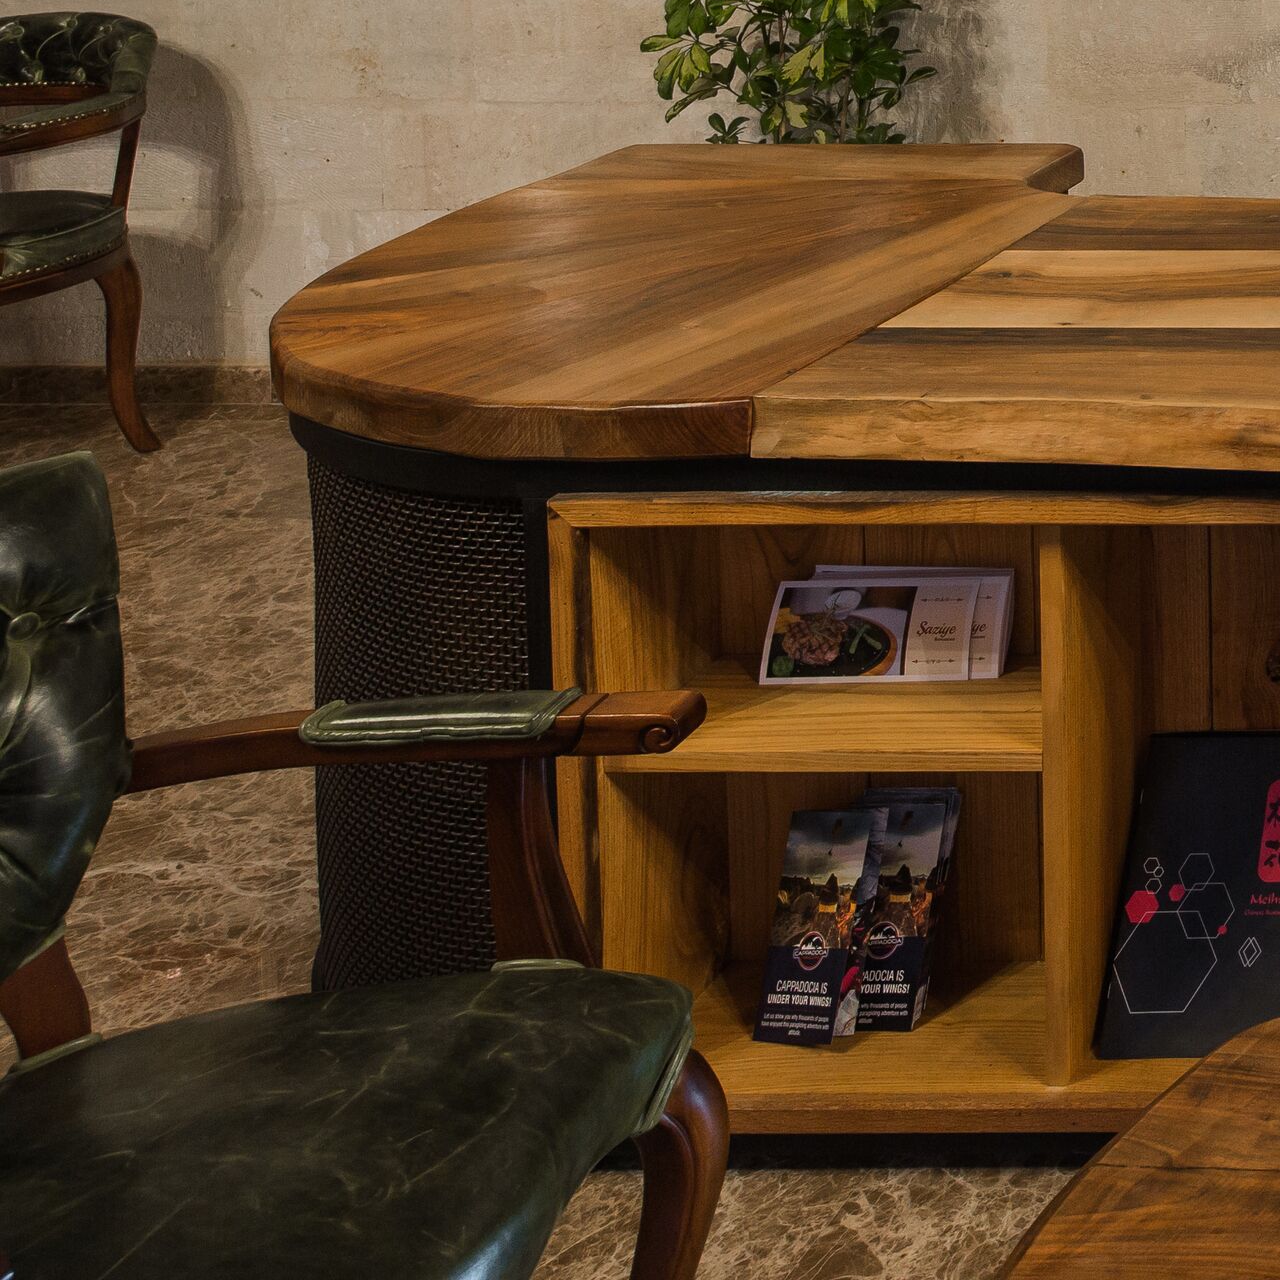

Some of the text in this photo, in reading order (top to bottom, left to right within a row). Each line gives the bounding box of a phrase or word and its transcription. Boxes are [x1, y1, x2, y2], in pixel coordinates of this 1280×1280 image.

[862, 970, 904, 981] ADOCIA IS
[776, 980, 828, 993] CAPPADOCIA IS
[860, 984, 910, 994] YOUR WINGS!
[768, 994, 832, 1007] UNDER YOUR WINGS!
